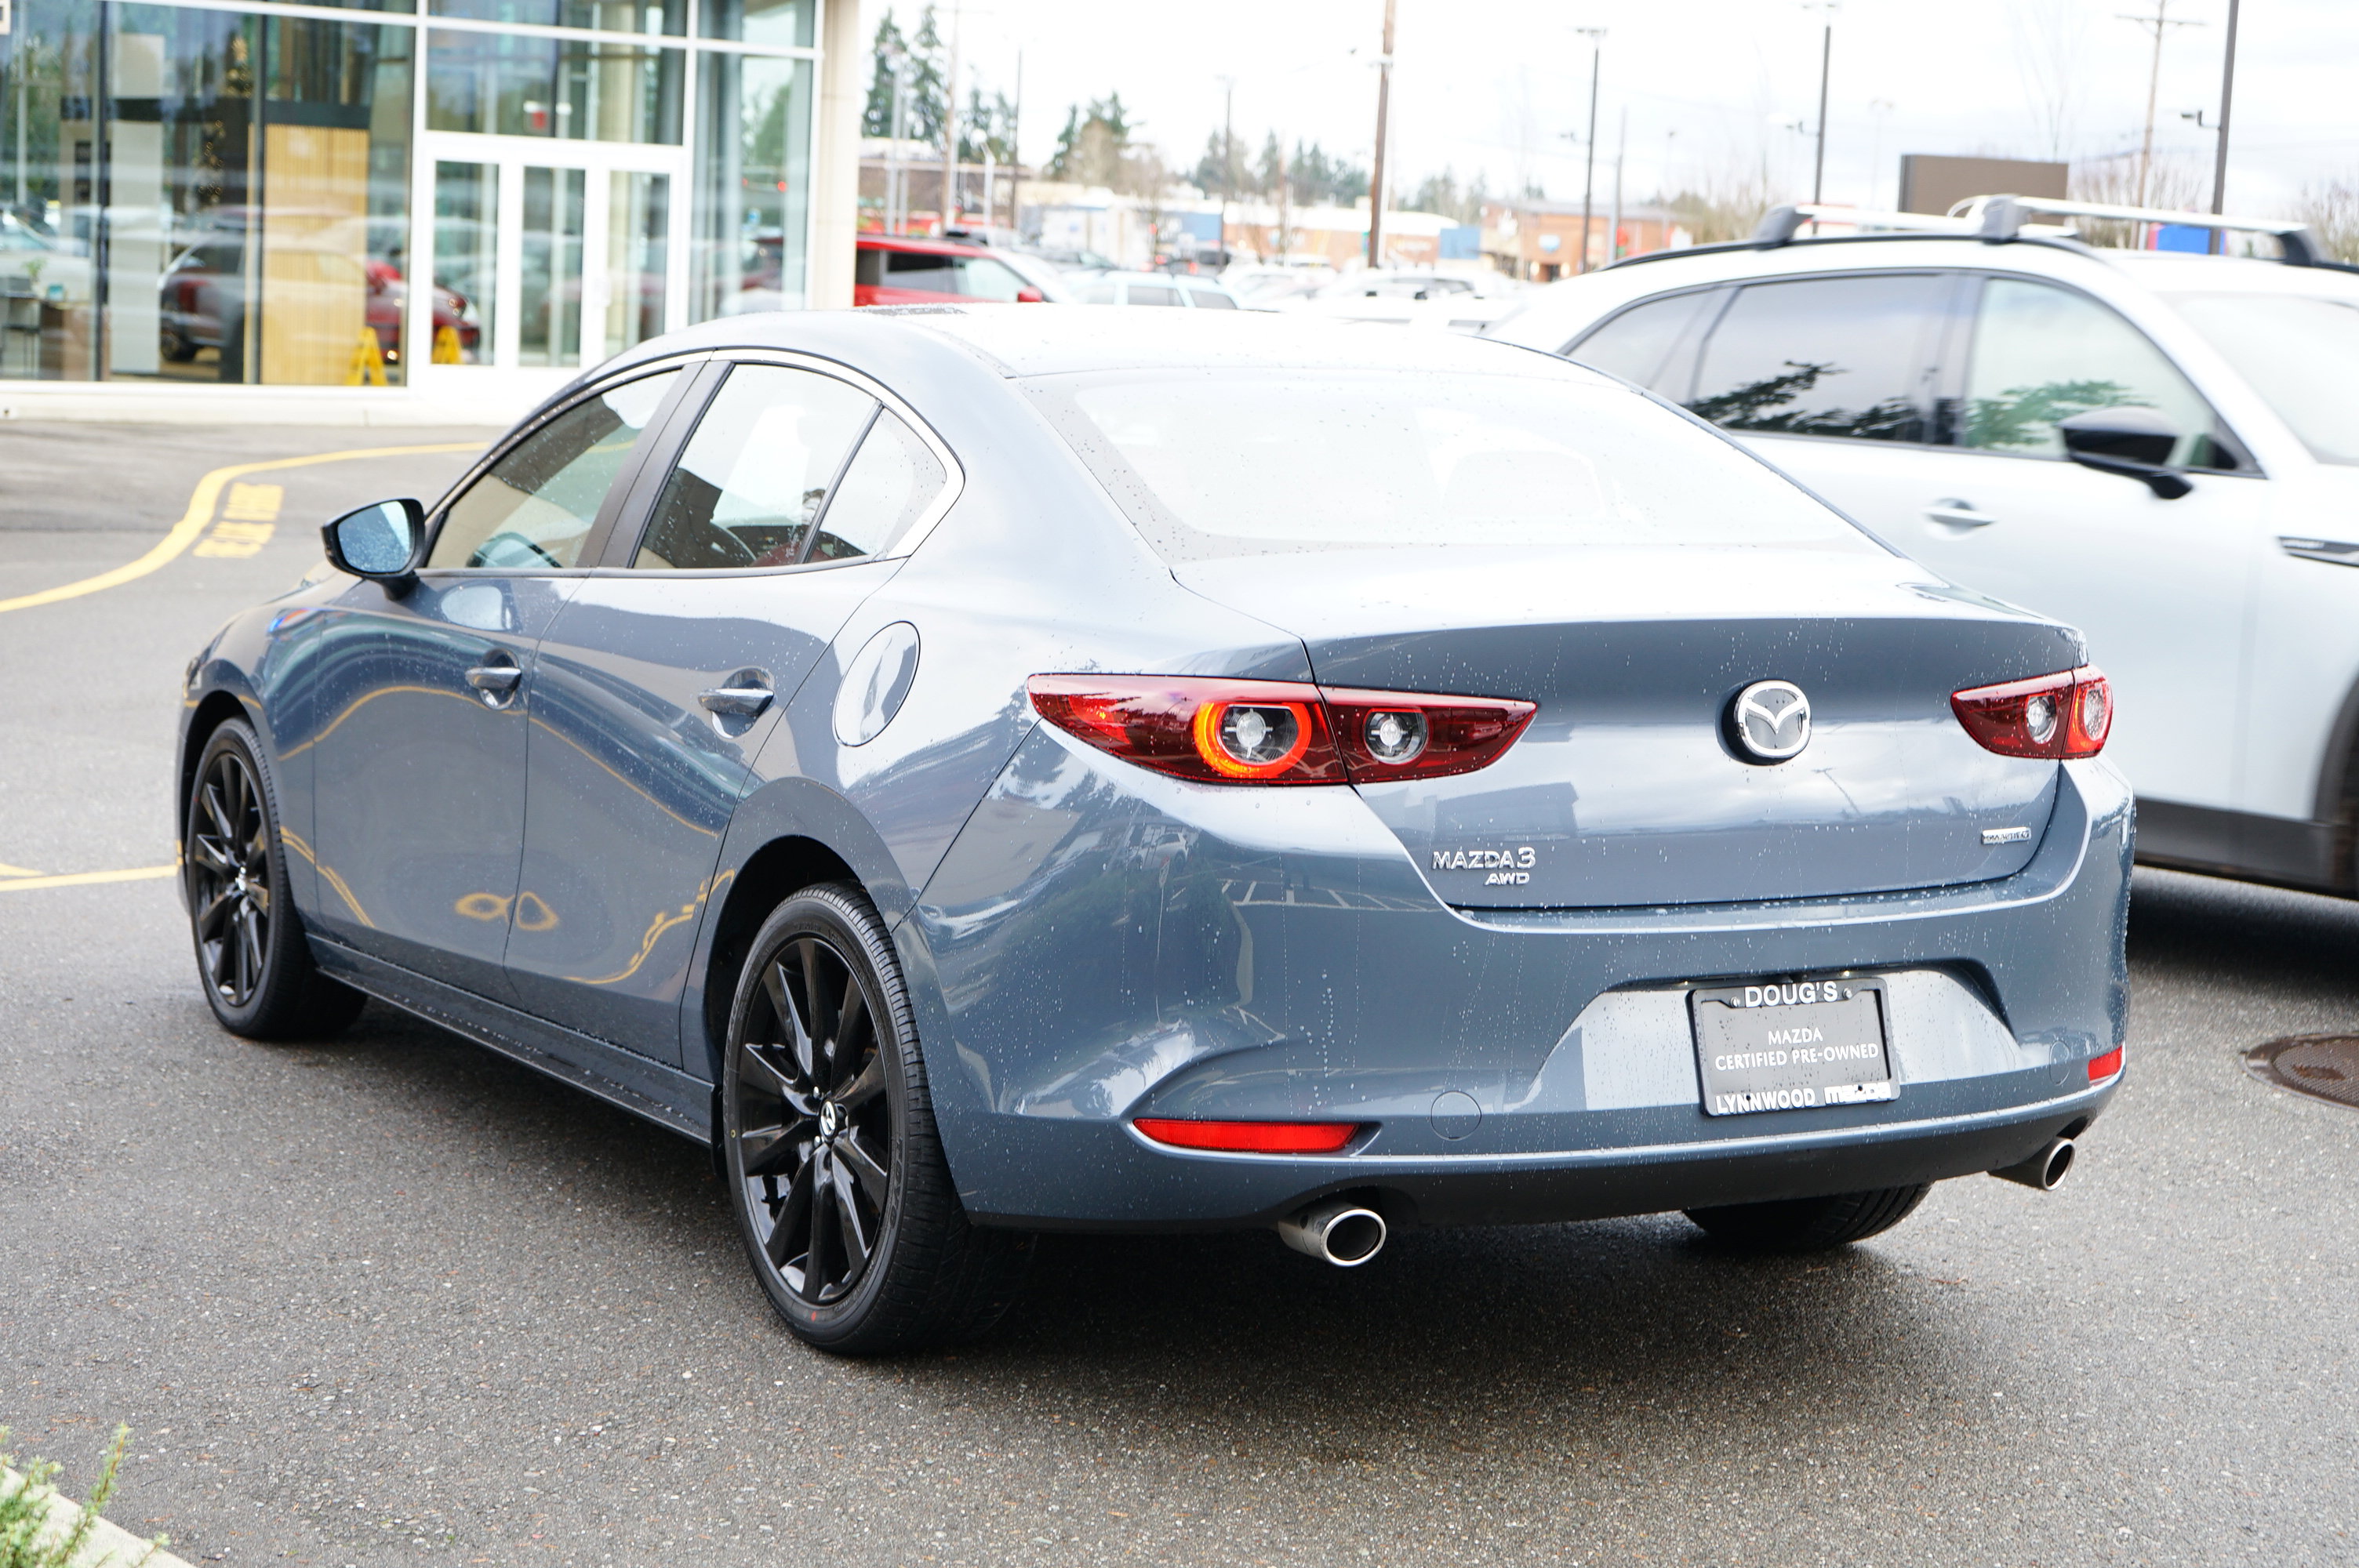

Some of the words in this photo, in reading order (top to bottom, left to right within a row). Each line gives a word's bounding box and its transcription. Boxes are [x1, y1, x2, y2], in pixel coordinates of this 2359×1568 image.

[1484, 872, 1530, 886] AWD
[1744, 981, 1838, 1007] DOUG'S
[1768, 1027, 1823, 1045] MAZDA
[1715, 1051, 1787, 1071] CERTIFIED
[1792, 1043, 1879, 1065] PRE-OWNED
[1715, 1087, 1816, 1114] LYNNWOOD
[889, 1136, 904, 1230] TOYO
